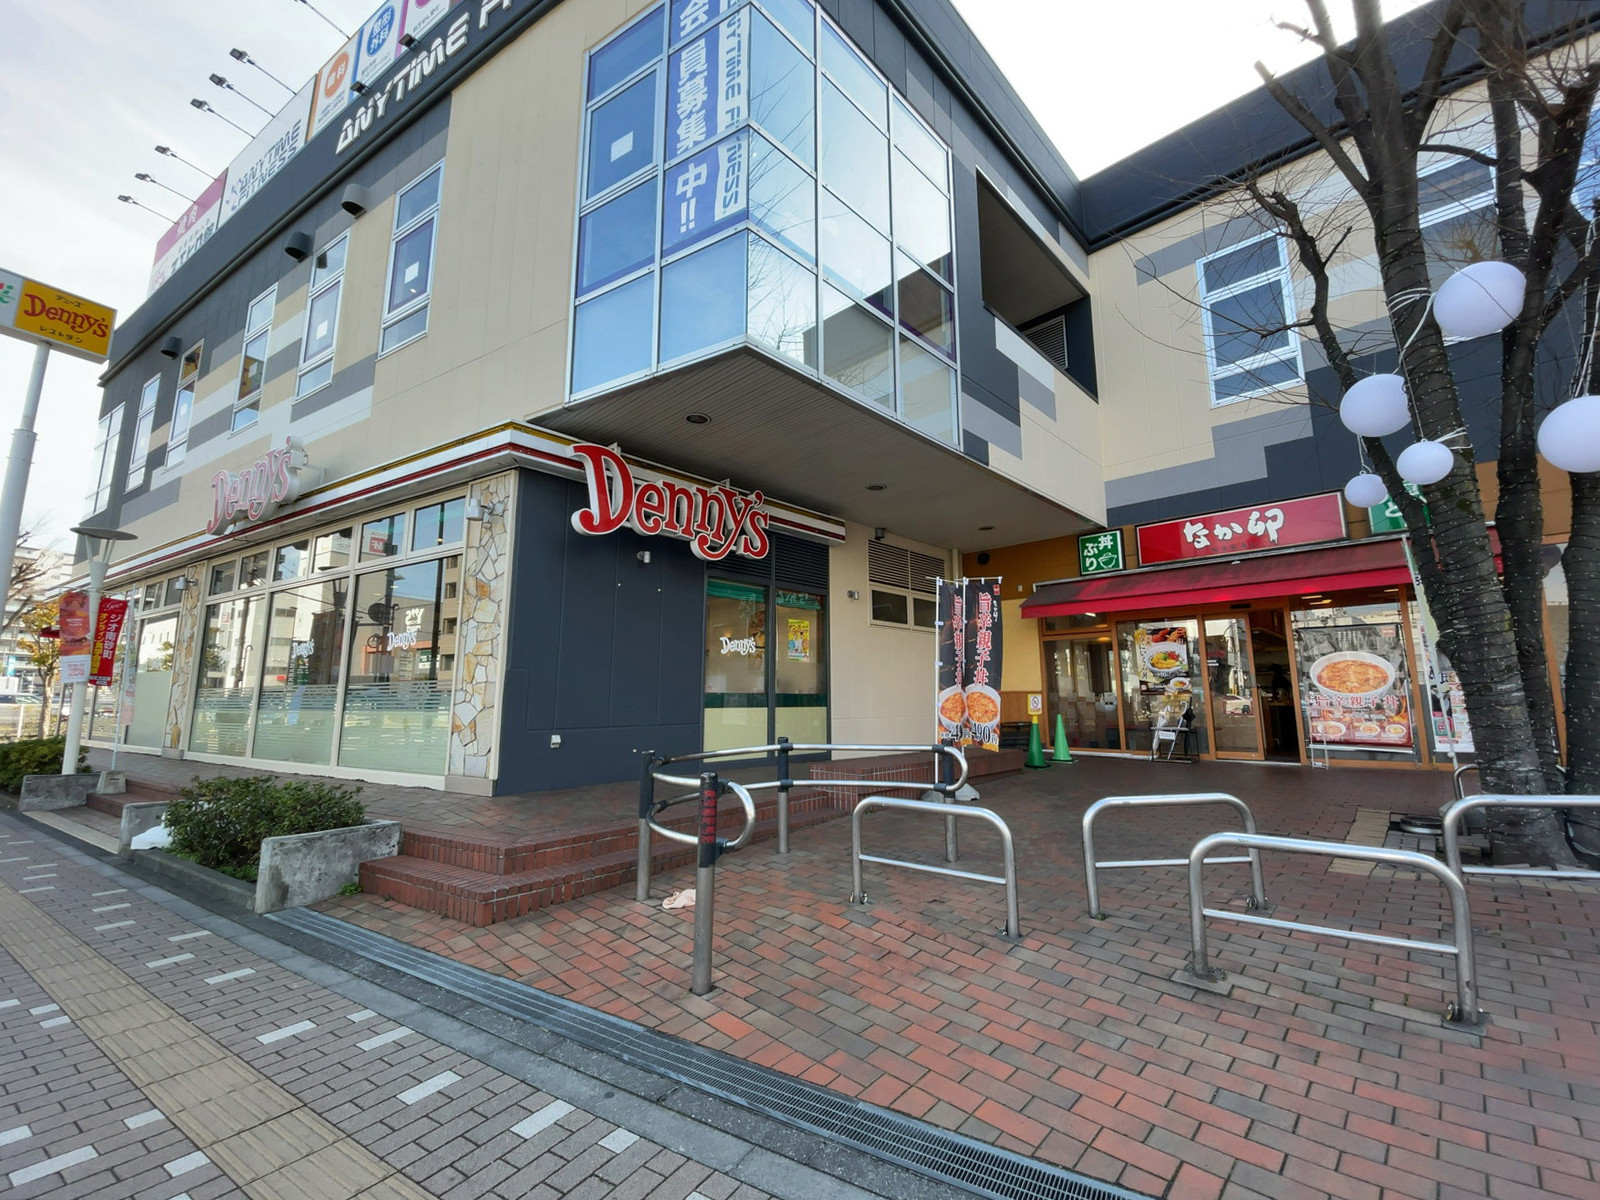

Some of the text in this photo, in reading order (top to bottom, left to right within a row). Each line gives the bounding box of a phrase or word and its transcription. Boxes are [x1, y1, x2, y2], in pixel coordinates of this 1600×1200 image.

[335, 11, 470, 155] ANYTIME
[237, 138, 299, 207] FITNESS
[239, 119, 302, 194] ANYTIME
[23, 293, 108, 338] Denny's
[40, 325, 83, 344] レストラン
[206, 436, 293, 535] Denny's
[571, 444, 770, 562] Denny's
[1183, 508, 1285, 550] なか卯
[102, 613, 122, 660] ジオ南砂町
[291, 638, 315, 659] Denny's
[387, 632, 418, 652] Denny's
[719, 634, 756, 656] Denny's
[973, 591, 993, 688] 旨辛親子丼
